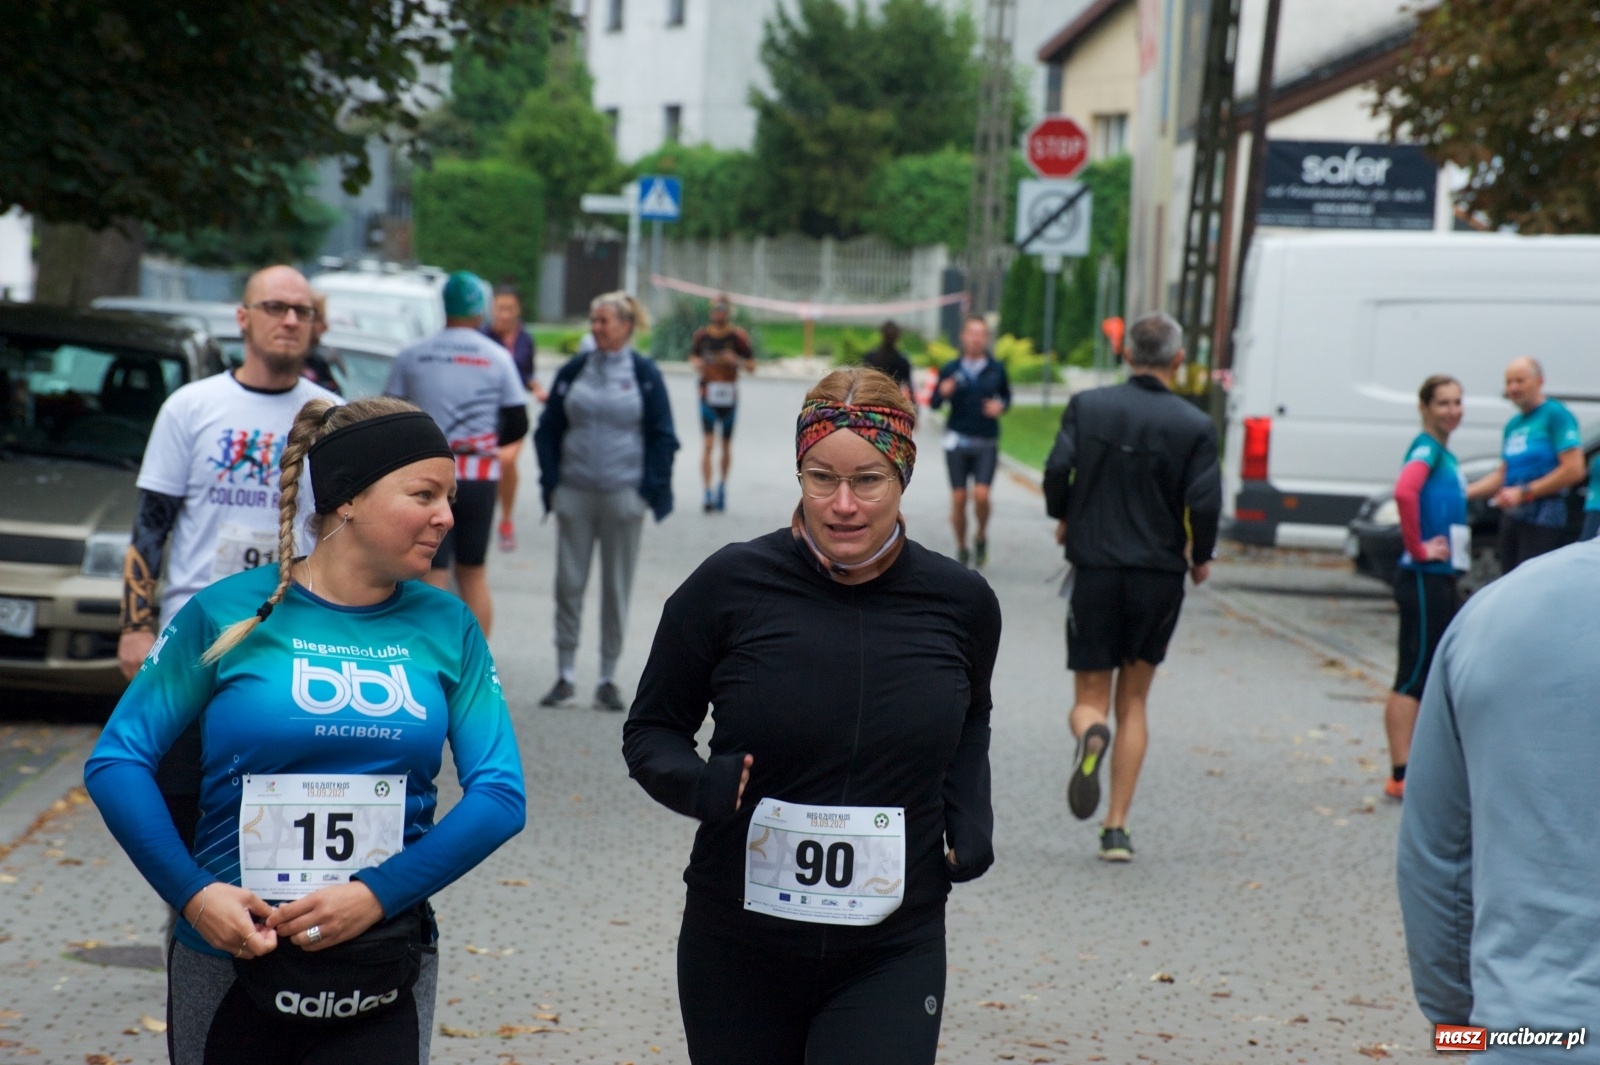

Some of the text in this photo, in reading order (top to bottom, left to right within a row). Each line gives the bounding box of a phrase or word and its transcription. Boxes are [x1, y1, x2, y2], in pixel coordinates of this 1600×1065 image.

[1031, 136, 1084, 159] STOP
[1302, 146, 1392, 186] safer
[208, 487, 267, 507] COLOUR
[291, 658, 427, 720] bbl
[314, 724, 403, 740] RACIBÓRZ
[303, 781, 314, 789] BIEG
[307, 788, 345, 798] 19.09.2021
[810, 819, 846, 828] 19.09.2021
[294, 812, 354, 862] 15
[795, 839, 855, 889] 90
[275, 988, 398, 1018] adidas
